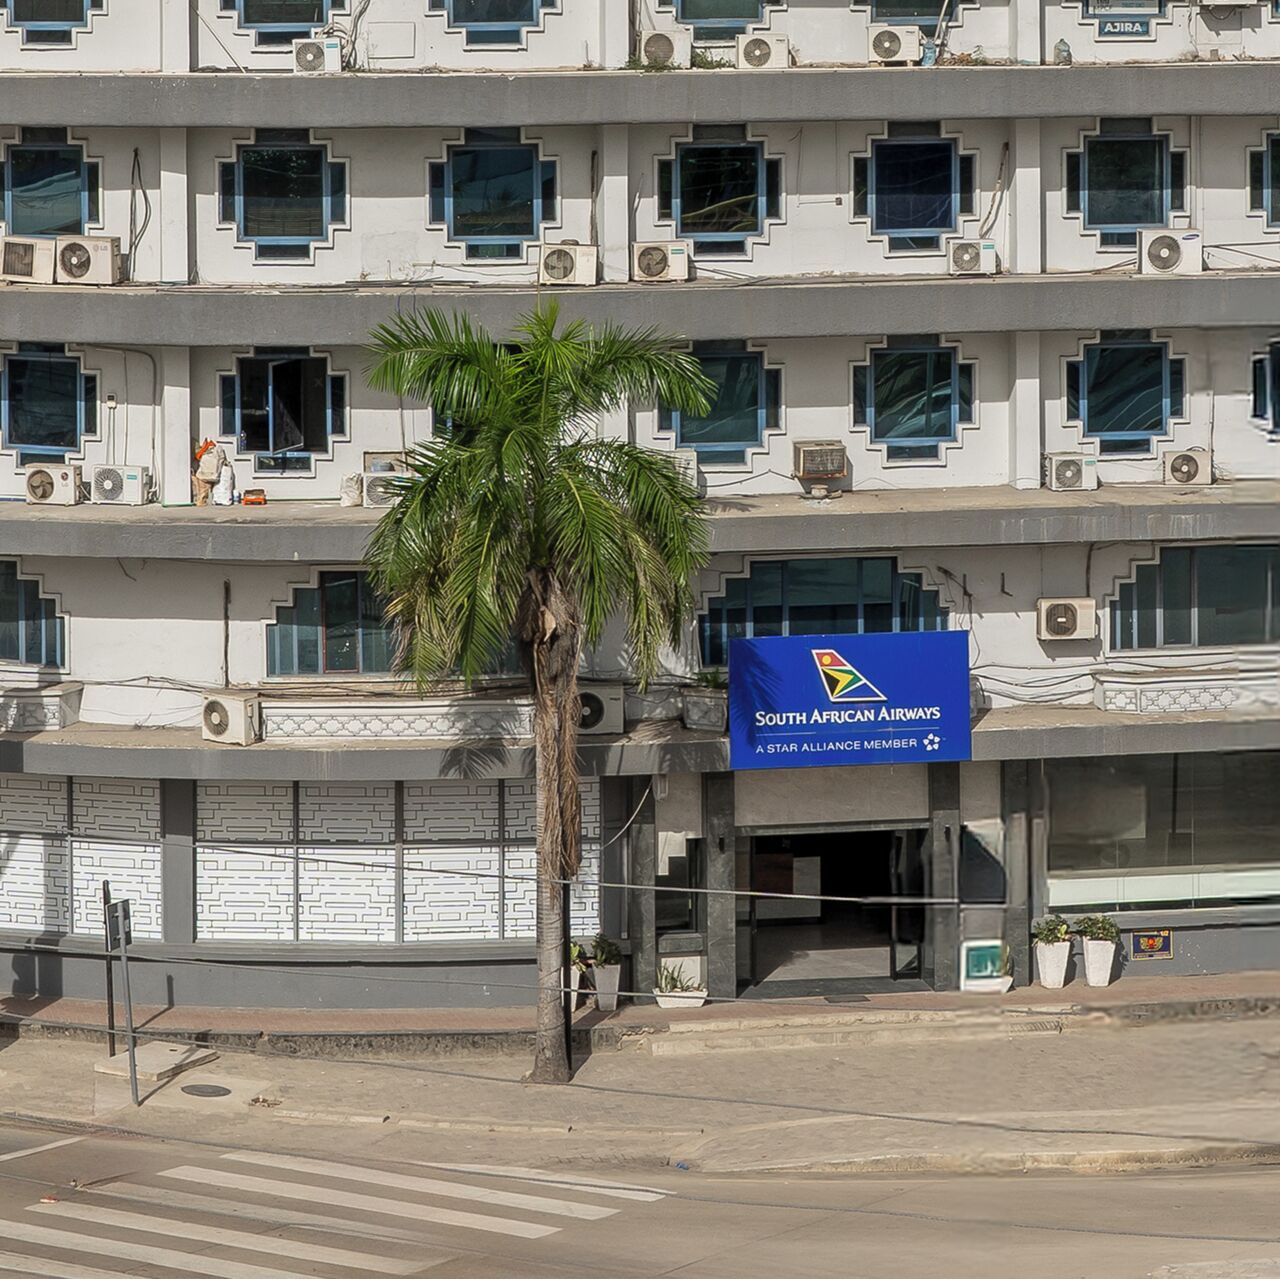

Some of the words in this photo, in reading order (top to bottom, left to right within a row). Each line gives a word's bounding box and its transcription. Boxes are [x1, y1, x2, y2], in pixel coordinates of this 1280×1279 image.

[1104, 22, 1143, 32] AJIRA
[755, 710, 807, 726] SOUTH
[810, 708, 875, 724] AFRICAN
[878, 706, 941, 722] AIRWAYS
[756, 744, 764, 754] A
[767, 743, 798, 753] STAR
[801, 741, 861, 752] ALLIANCE
[864, 738, 918, 750] MEMBER
